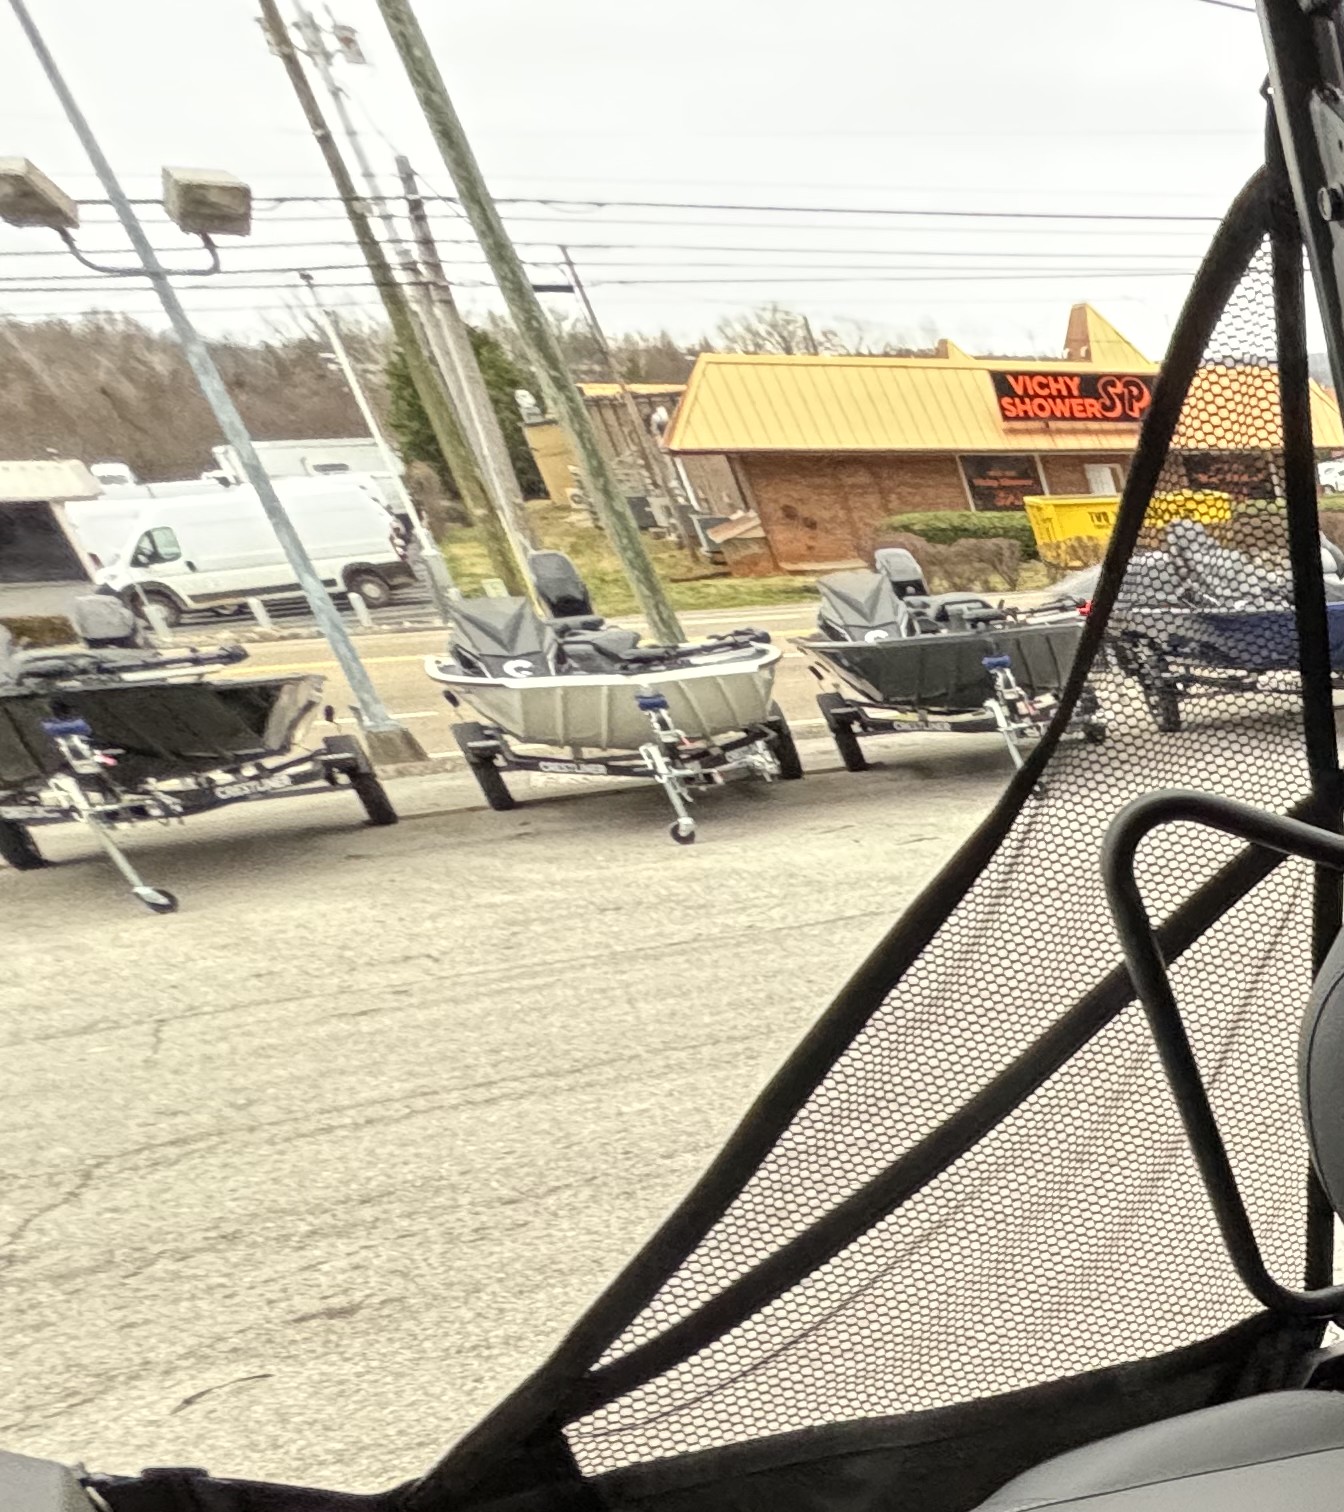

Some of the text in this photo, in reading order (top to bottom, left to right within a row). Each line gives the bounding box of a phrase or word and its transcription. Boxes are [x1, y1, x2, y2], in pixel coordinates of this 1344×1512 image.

[1000, 376, 1152, 418] SHOWER SP
[1005, 374, 1080, 396] VICHY
